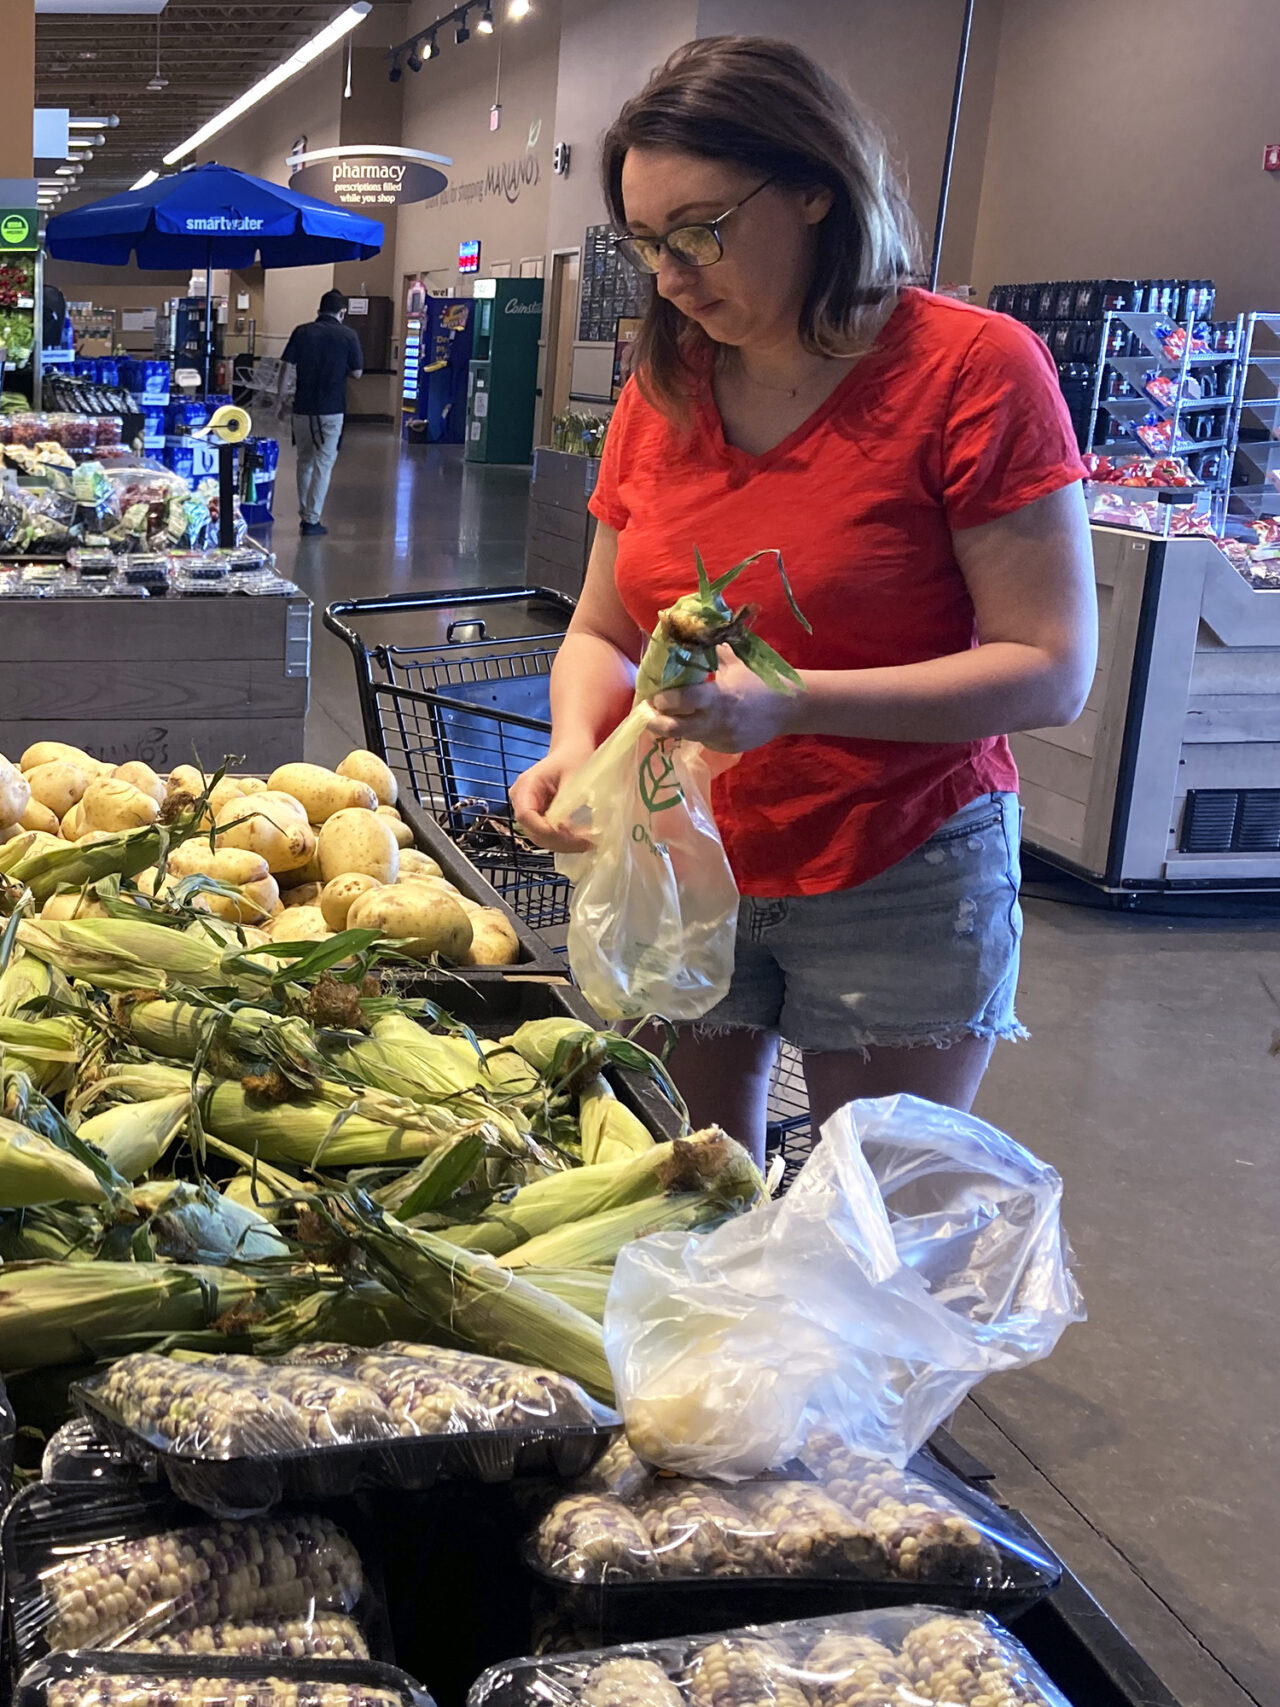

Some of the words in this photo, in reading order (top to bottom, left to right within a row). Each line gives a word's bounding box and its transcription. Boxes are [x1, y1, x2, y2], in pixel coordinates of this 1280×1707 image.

[332, 161, 407, 182] pharmacy
[334, 182, 382, 193] prescriptions
[383, 182, 402, 192] filled
[340, 193, 361, 203] while
[361, 195, 376, 204] you
[377, 193, 396, 204] shop
[186, 216, 264, 231] smartwater
